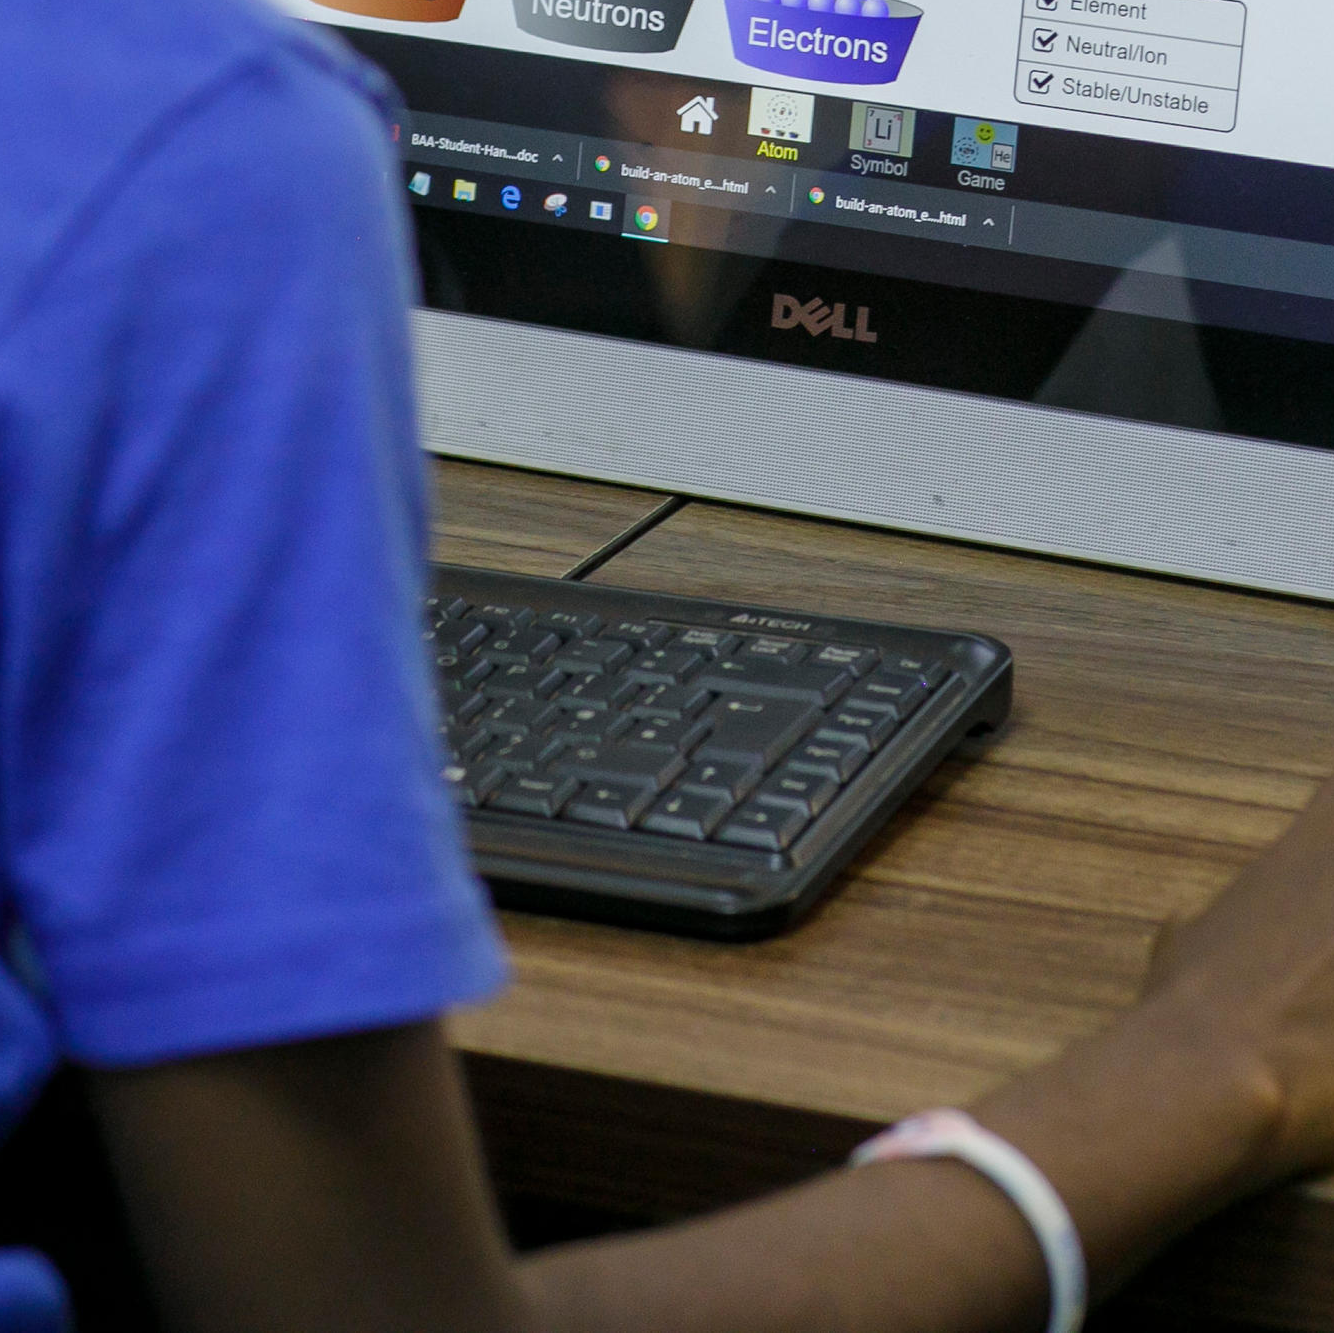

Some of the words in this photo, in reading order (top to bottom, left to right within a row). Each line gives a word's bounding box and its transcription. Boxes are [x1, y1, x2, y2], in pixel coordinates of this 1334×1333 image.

[747, 17, 889, 63] Electrons
[1066, 35, 1168, 66] Neutral/Ion
[1062, 77, 1209, 114] Stable/Unstable
[875, 118, 892, 140] Li
[756, 140, 799, 161] Atom
[994, 150, 1011, 163] He
[850, 154, 908, 177] Symbol
[957, 169, 1006, 191] Game
[771, 293, 878, 343] DELL
